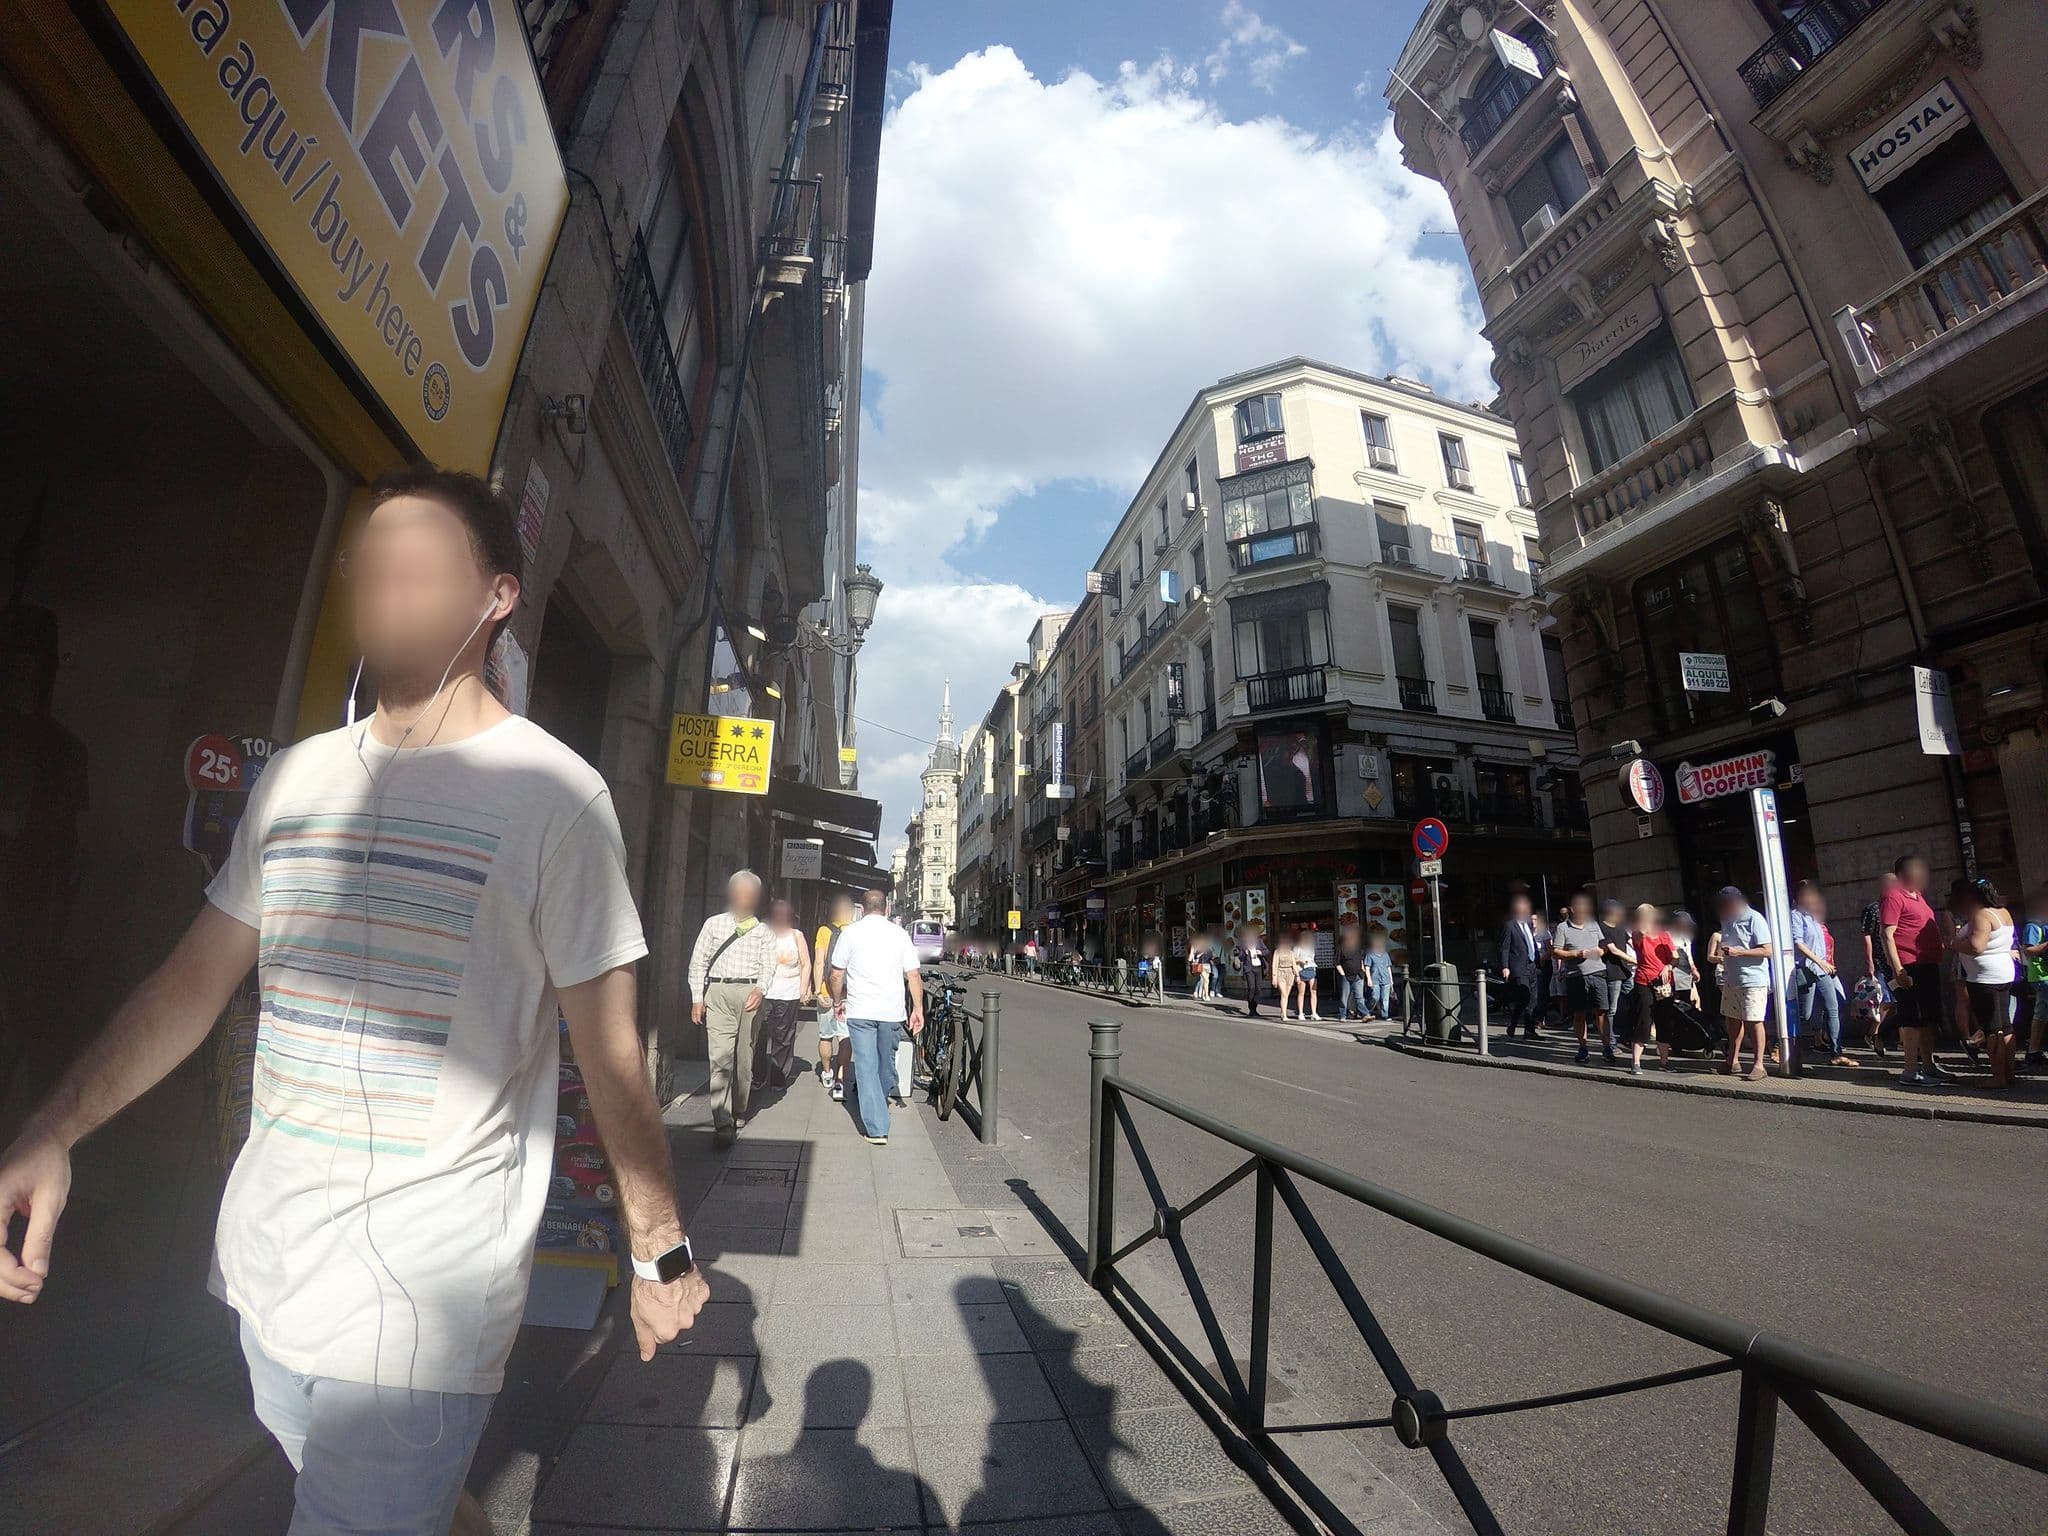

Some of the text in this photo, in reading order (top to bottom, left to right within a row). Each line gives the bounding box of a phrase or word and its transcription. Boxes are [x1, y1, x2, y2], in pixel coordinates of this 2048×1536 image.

[1858, 96, 1955, 173] HOSTAL
[219, 41, 318, 186] aquí
[310, 174, 375, 302] buy
[364, 262, 422, 376] here
[503, 191, 528, 266] &
[1239, 440, 1285, 455] HOSTEL
[1250, 451, 1275, 462] THC
[1686, 670, 1728, 680] ALQUILA
[1686, 678, 1729, 689] 911 569 222
[677, 717, 721, 738] HOSTAL
[680, 739, 760, 764] GUERRA
[198, 748, 239, 784] 25€
[1700, 753, 1768, 782] DUNKIN'
[1703, 769, 1768, 796] COFFEE
